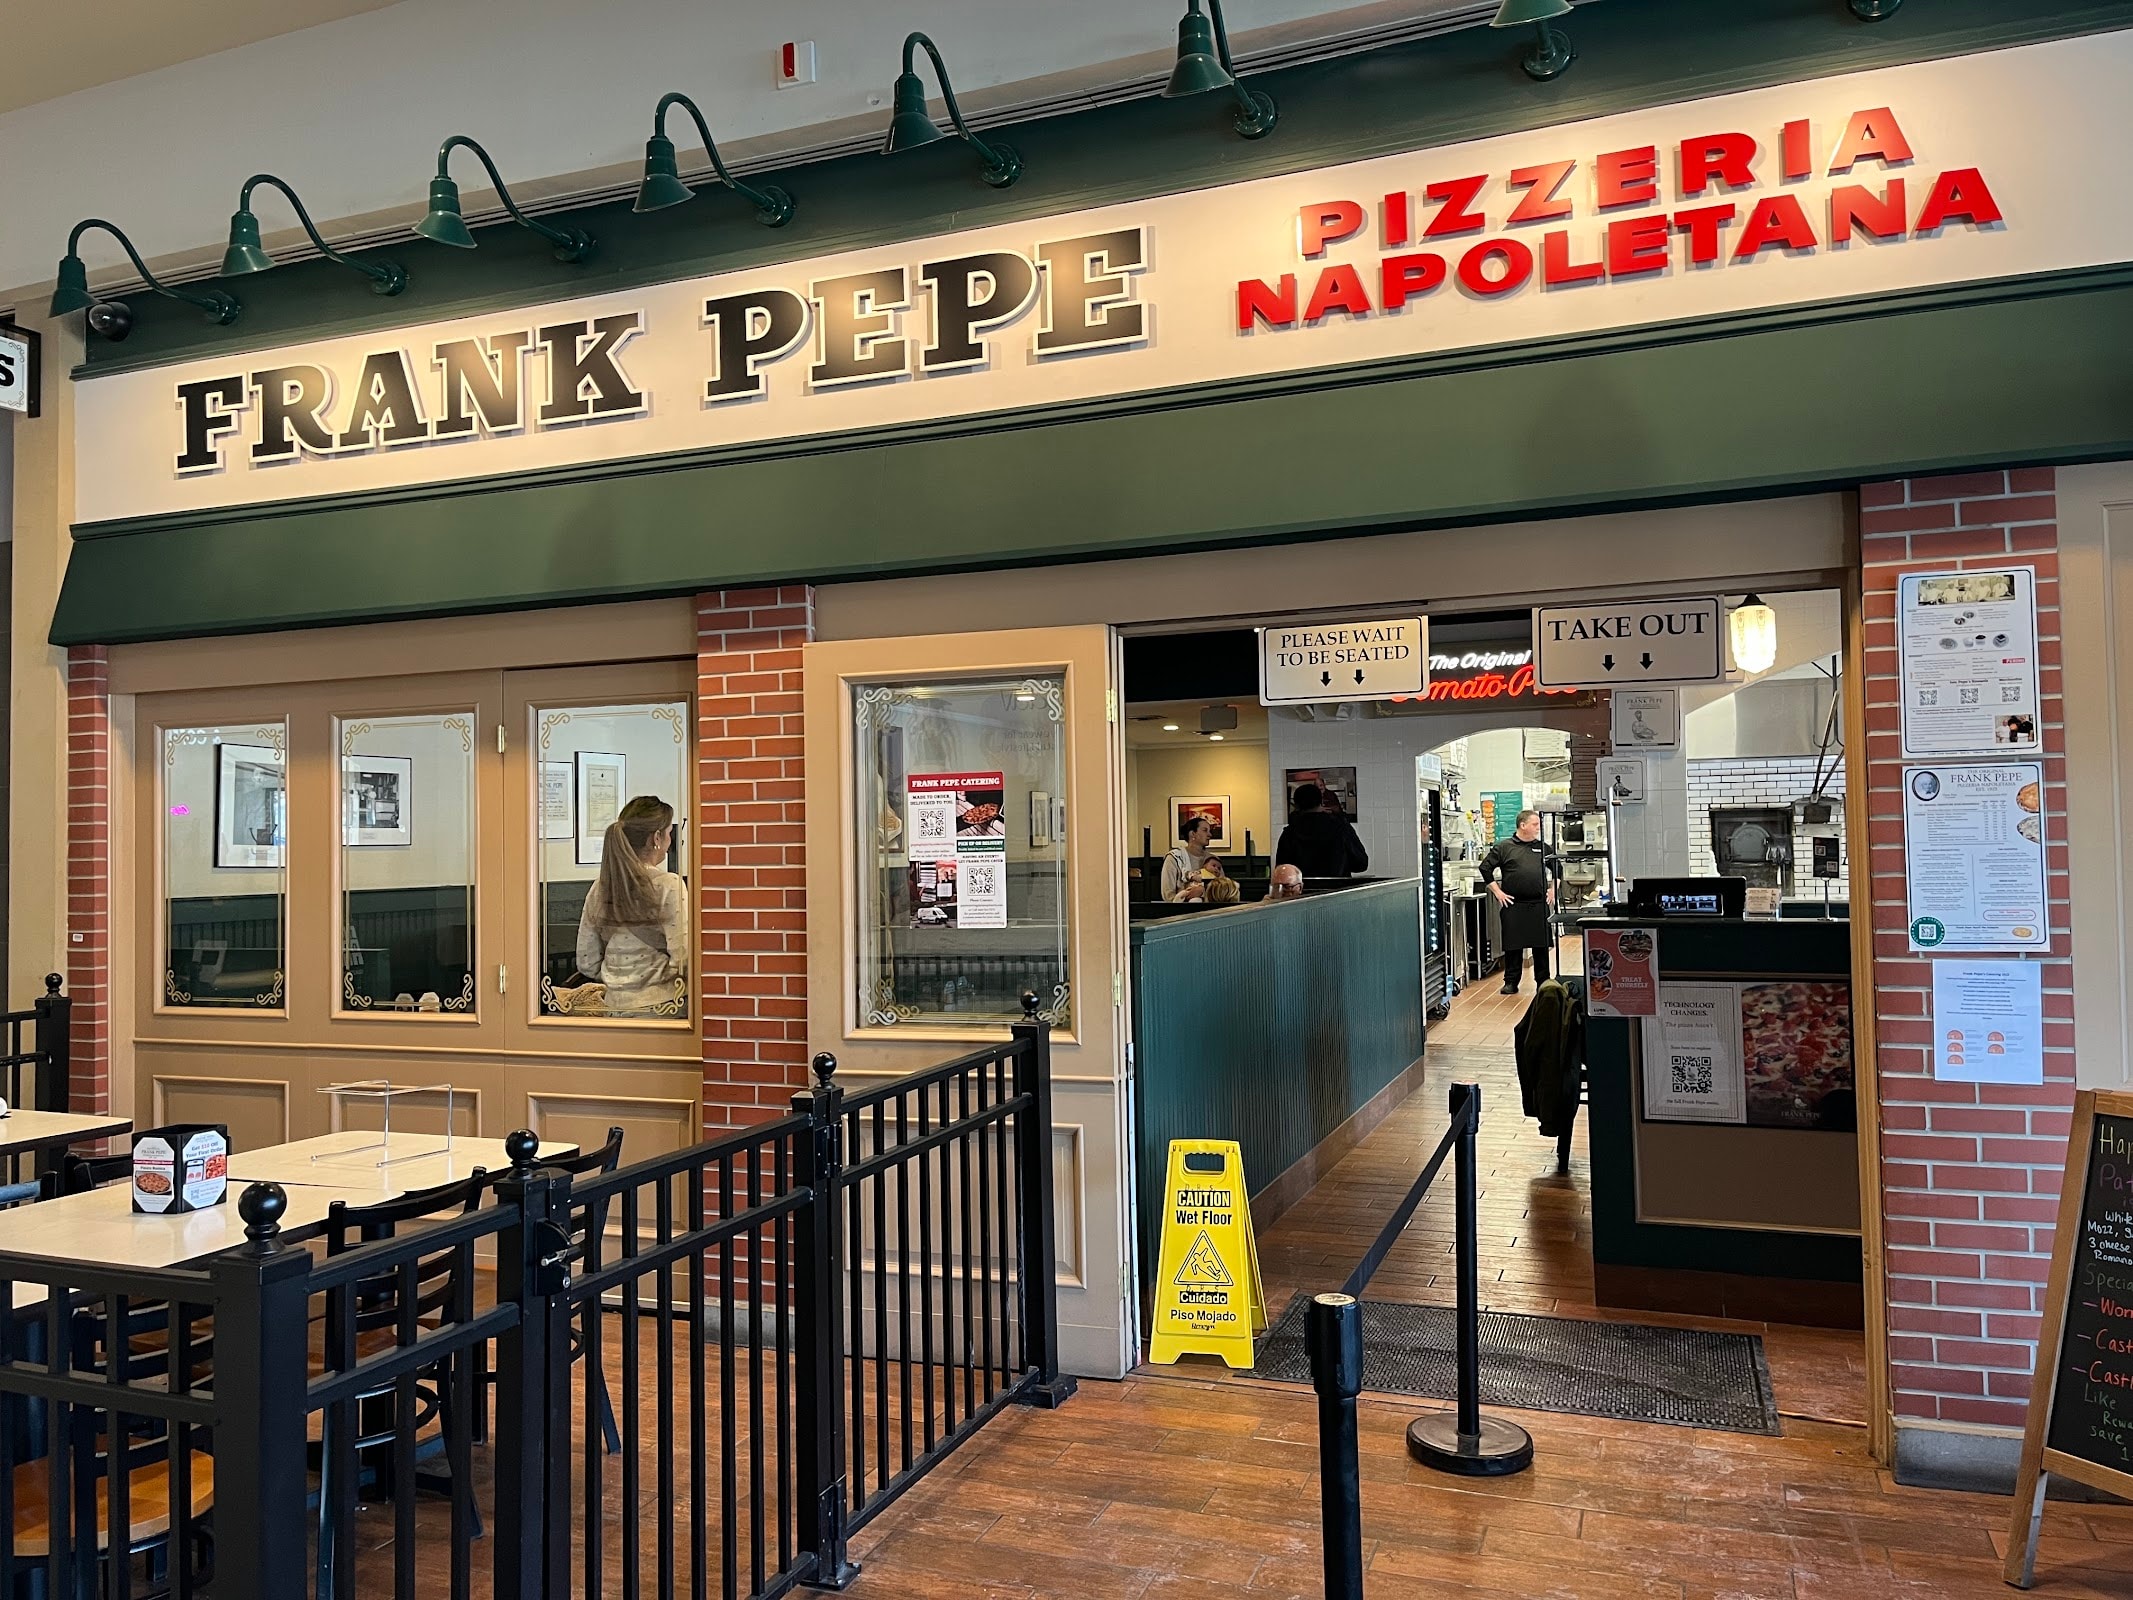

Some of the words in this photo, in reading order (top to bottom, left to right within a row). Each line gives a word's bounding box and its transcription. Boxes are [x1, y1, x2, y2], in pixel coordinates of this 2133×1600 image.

[1300, 107, 1914, 256] PIZZERIA
[1236, 167, 2003, 330] NAPOLETANA
[175, 309, 648, 473] FRANK
[702, 225, 1149, 402] PEPE
[1548, 616, 1632, 641] TAKE
[1639, 612, 1709, 636] OUT
[1281, 631, 1349, 648] PLEASE
[1352, 627, 1405, 644] WAIT
[1277, 652, 1304, 667] TO
[1309, 651, 1331, 665] BE
[1335, 645, 1409, 663] SEATED
[1428, 654, 1459, 670] The
[1460, 650, 1533, 670] Original
[911, 779, 939, 788] FRANK
[940, 778, 960, 787] PEPE
[960, 777, 1000, 786] CATERING
[1950, 773, 1991, 783] FRANK
[1995, 772, 2023, 782] PEPE
[1177, 1191, 1230, 1207] CAUTION
[1176, 1210, 1198, 1224] Wet
[1202, 1210, 1232, 1225] Floor
[2088, 1237, 2096, 1248] 3
[1180, 1292, 1227, 1304] Cuidado
[1170, 1309, 1194, 1320] Piso
[1196, 1310, 1237, 1323] Mojado
